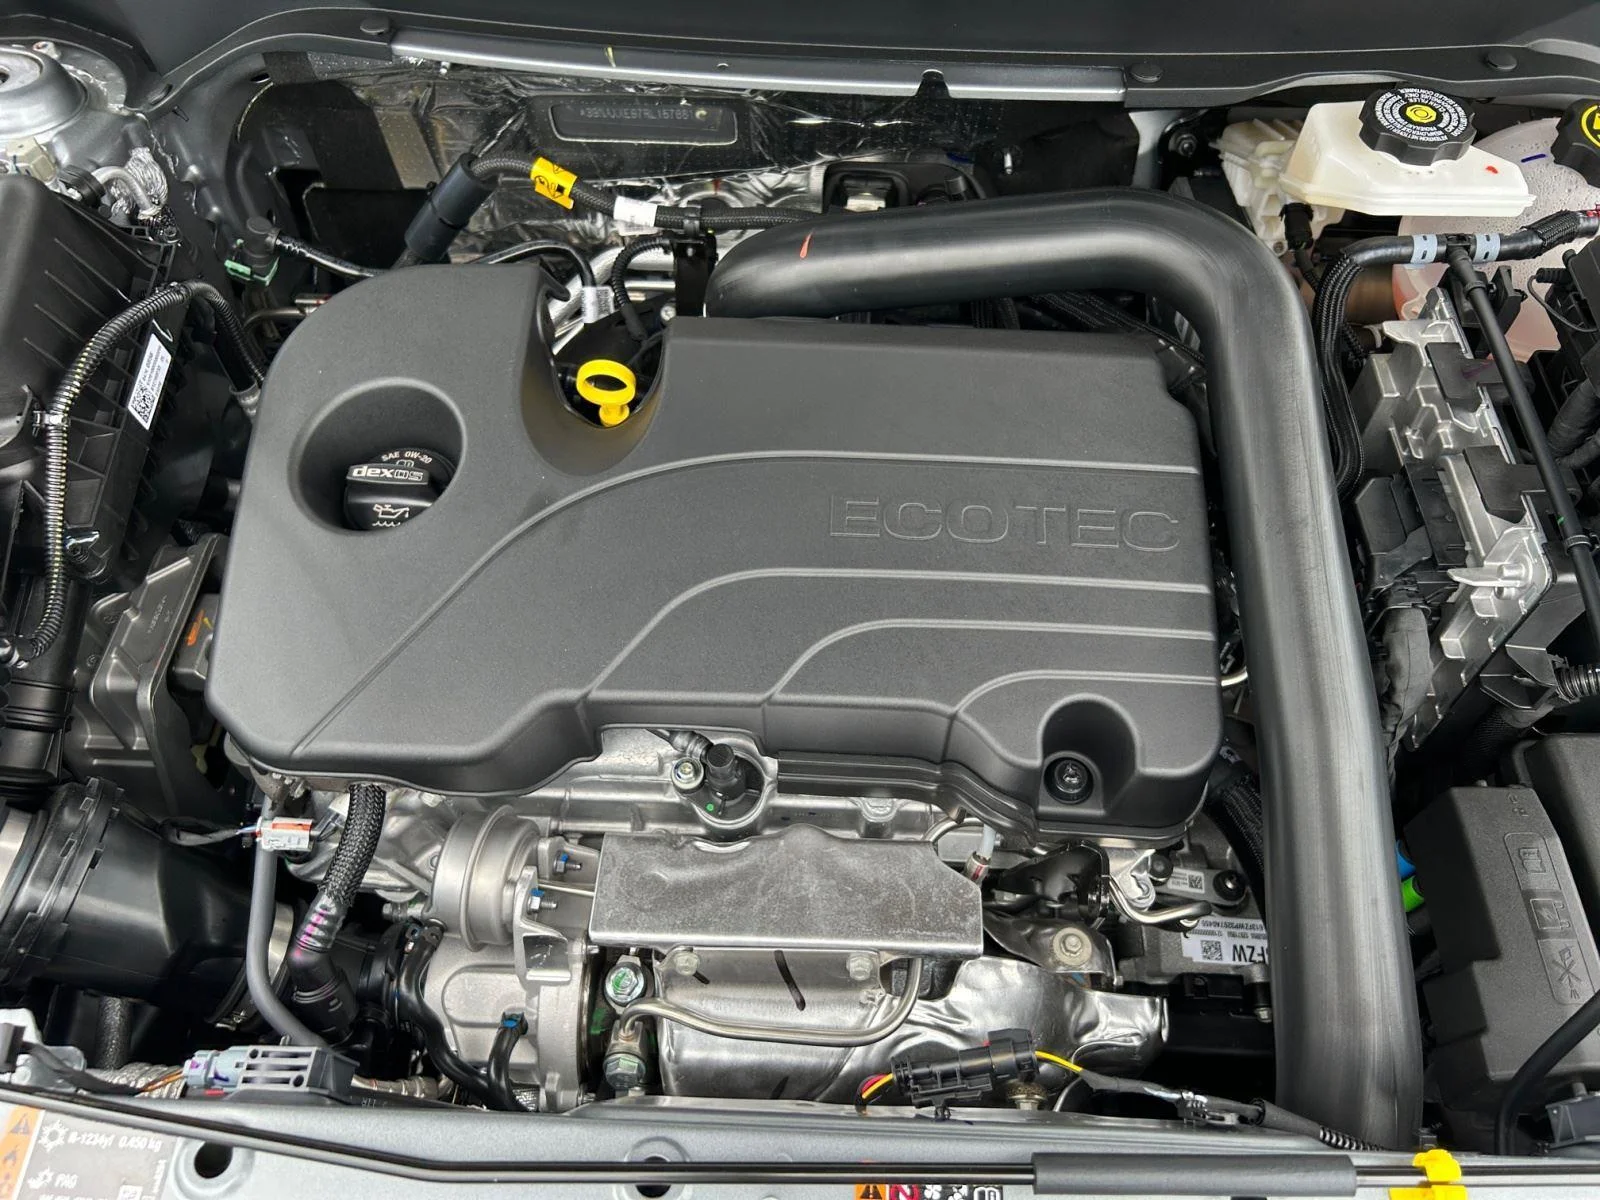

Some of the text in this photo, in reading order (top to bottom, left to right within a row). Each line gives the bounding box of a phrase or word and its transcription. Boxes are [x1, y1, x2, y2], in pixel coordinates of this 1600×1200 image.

[381, 451, 433, 464] SAE 0W-20
[352, 466, 424, 481] dexos
[828, 495, 1181, 553] ECOTEC
